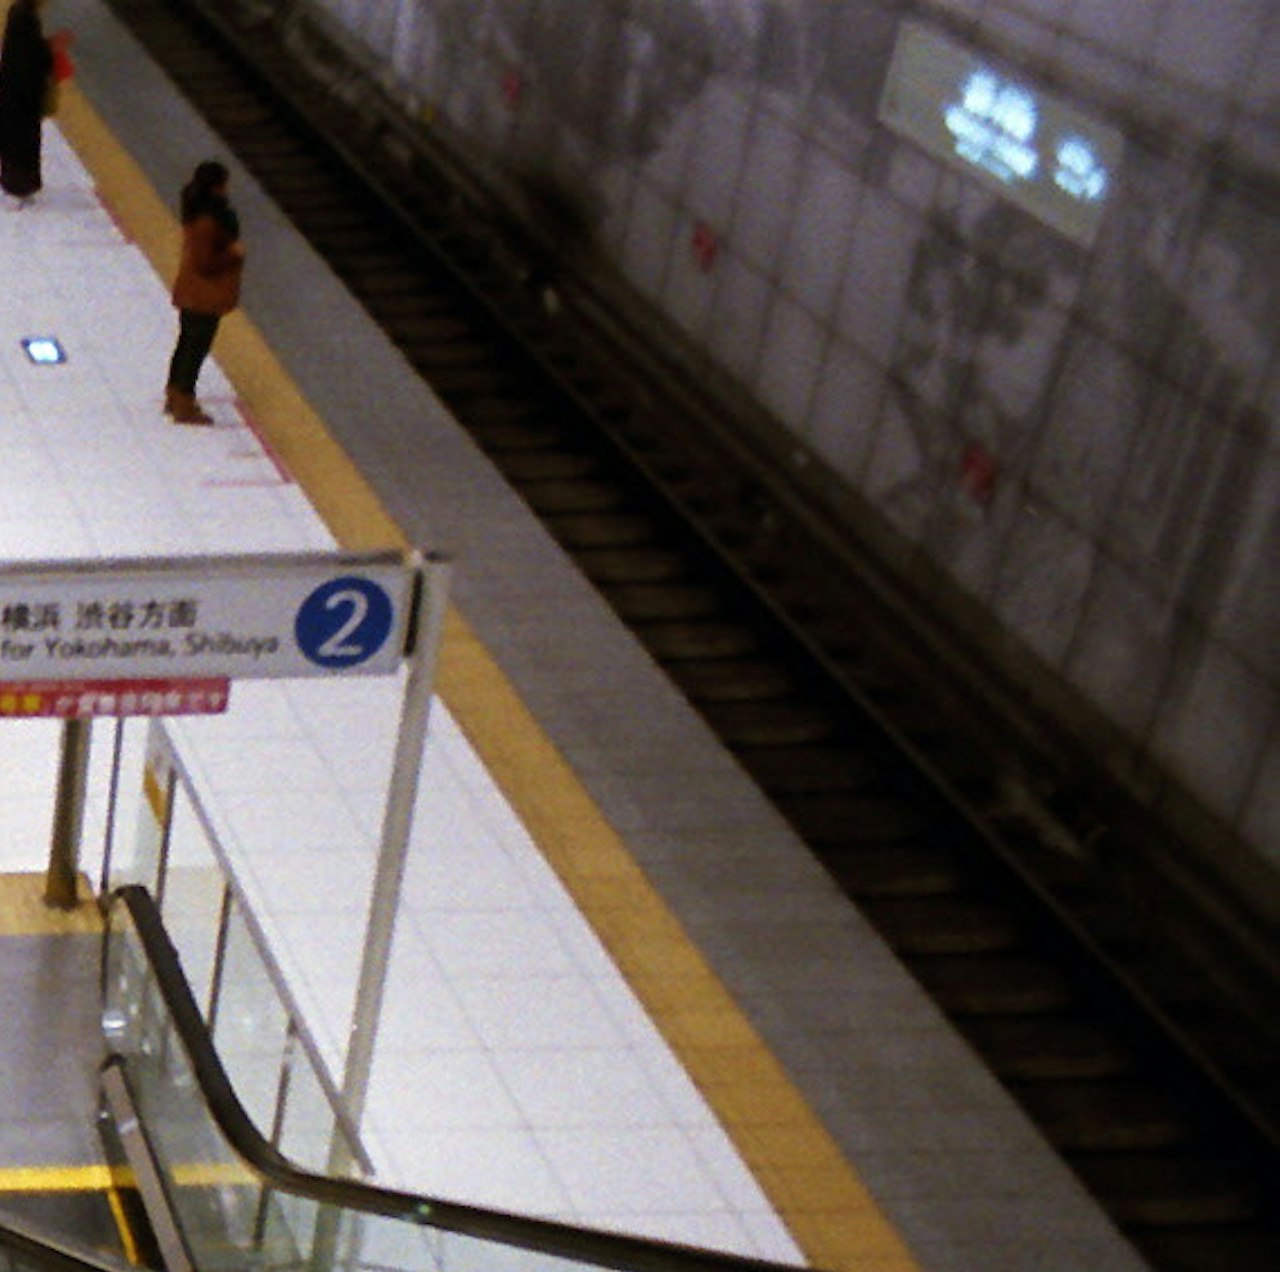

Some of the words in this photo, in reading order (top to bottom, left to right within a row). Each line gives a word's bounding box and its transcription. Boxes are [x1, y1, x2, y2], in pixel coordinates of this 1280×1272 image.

[1, 602, 61, 631] 横浜
[317, 589, 369, 657] 2
[1, 638, 35, 661] for
[183, 631, 279, 659] Shibuya
